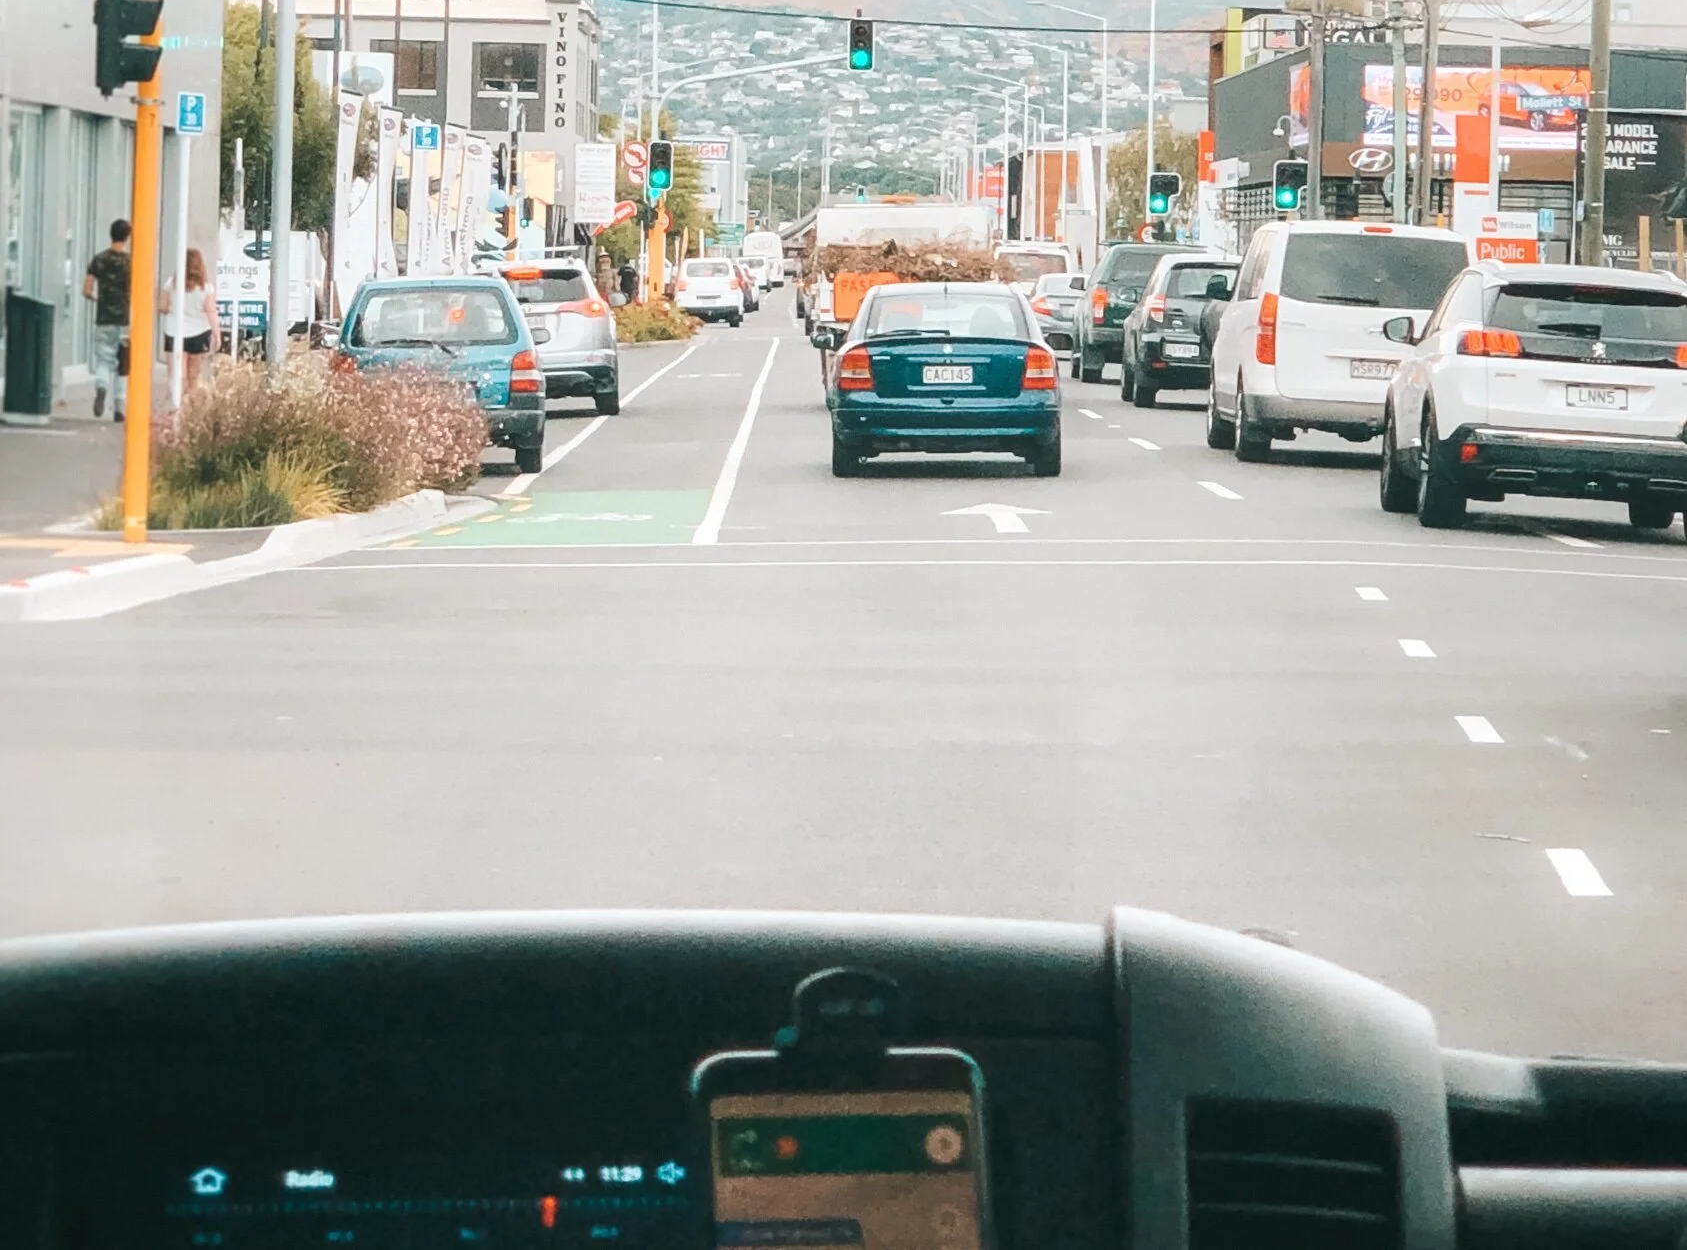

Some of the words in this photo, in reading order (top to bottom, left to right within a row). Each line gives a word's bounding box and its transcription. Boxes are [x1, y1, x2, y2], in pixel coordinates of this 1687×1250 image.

[556, 12, 568, 67] VINO
[554, 73, 567, 128] FINO
[1614, 124, 1658, 138] MODEL
[1604, 156, 1636, 170] SALE
[1499, 221, 1532, 230] Wilson
[1480, 242, 1525, 261] Public
[924, 367, 972, 382] CAC145
